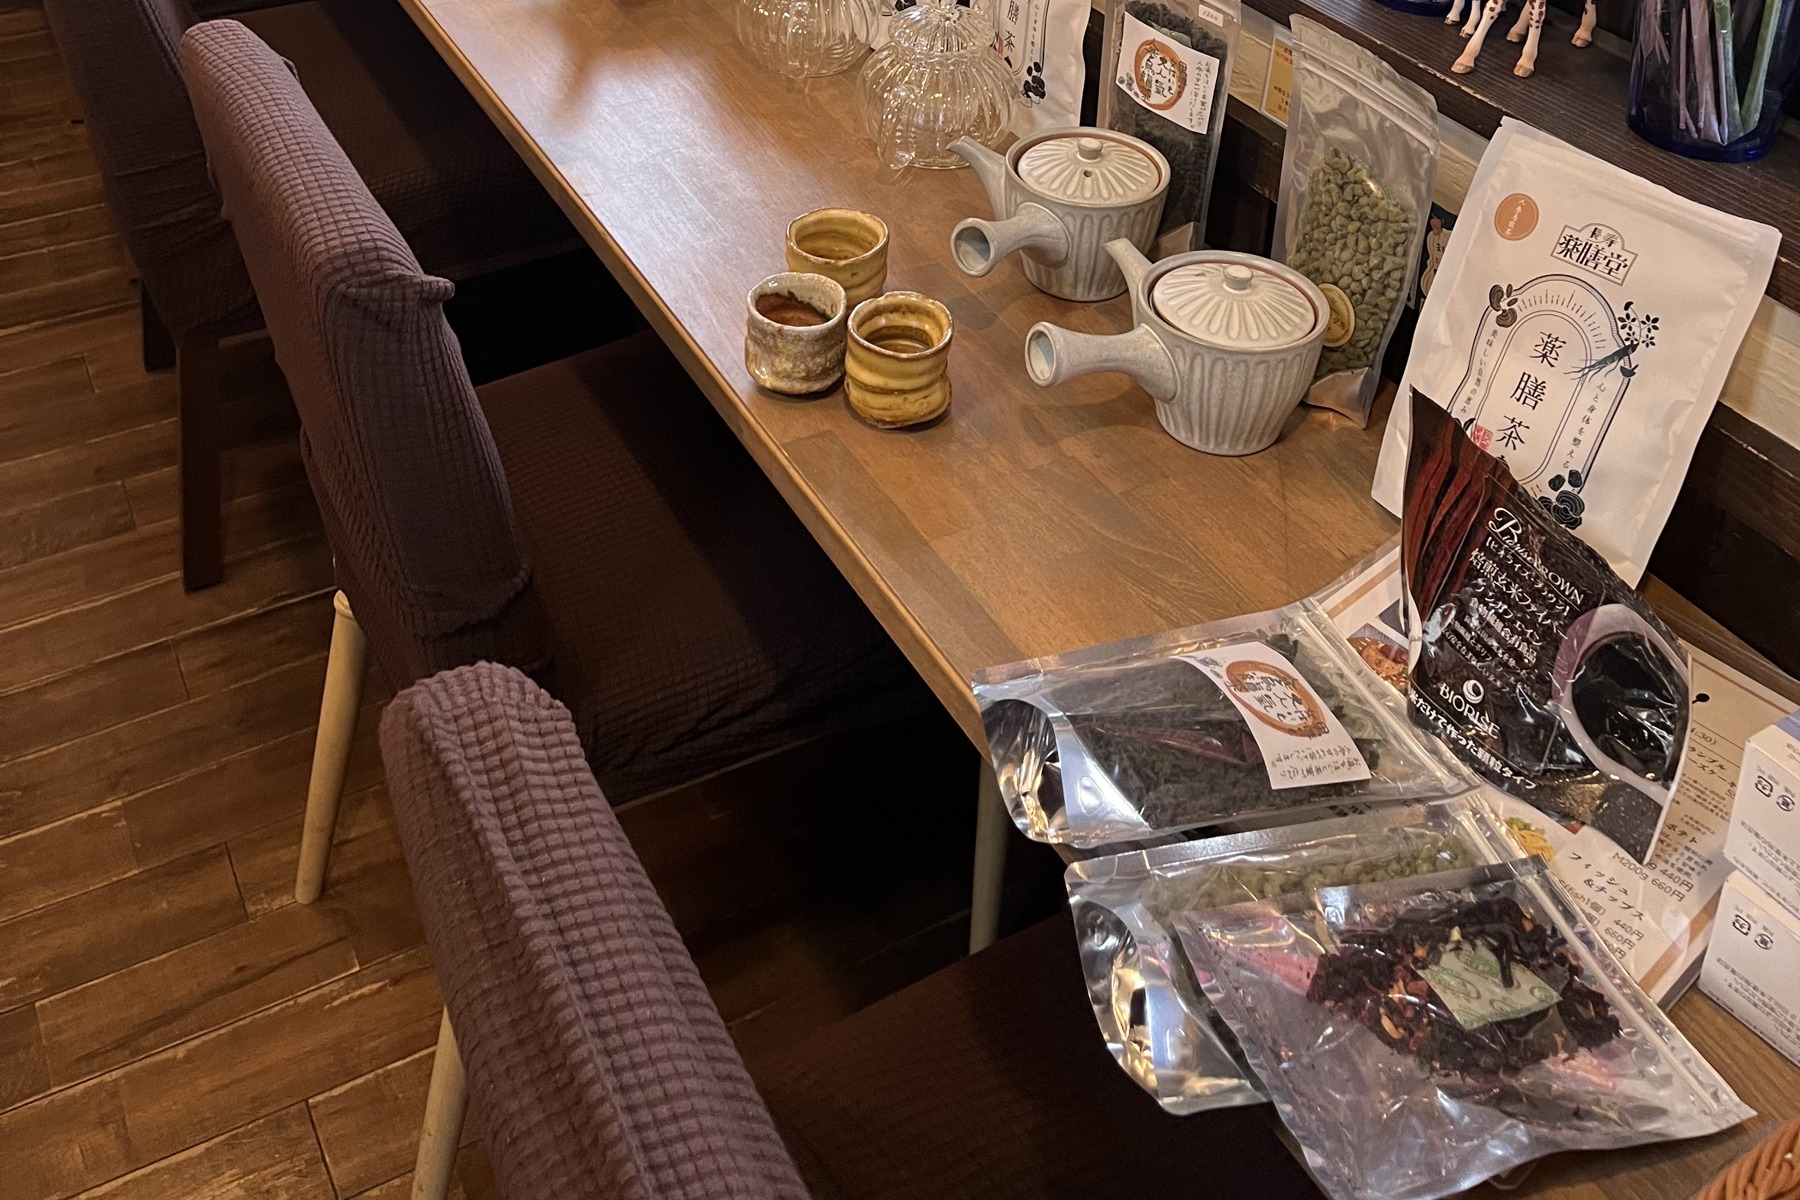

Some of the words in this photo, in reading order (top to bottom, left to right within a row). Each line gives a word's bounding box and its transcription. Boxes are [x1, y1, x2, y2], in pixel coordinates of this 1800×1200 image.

[1557, 234, 1628, 280] 薬膳堂
[1590, 227, 1619, 247] 長寿
[1496, 330, 1566, 452] 薬膳茶
[1562, 381, 1607, 470] 心と身体を整える
[1469, 547, 1570, 638] 焙煎玄米ファイバー
[1440, 682, 1501, 740] BIORISE
[1568, 849, 1631, 898] フィッシュ
[1612, 851, 1650, 885] M200g
[1651, 875, 1687, 902] 660円
[1659, 866, 1694, 892] 440円
[1604, 927, 1636, 952] 660円
[1612, 918, 1645, 942] 440円
